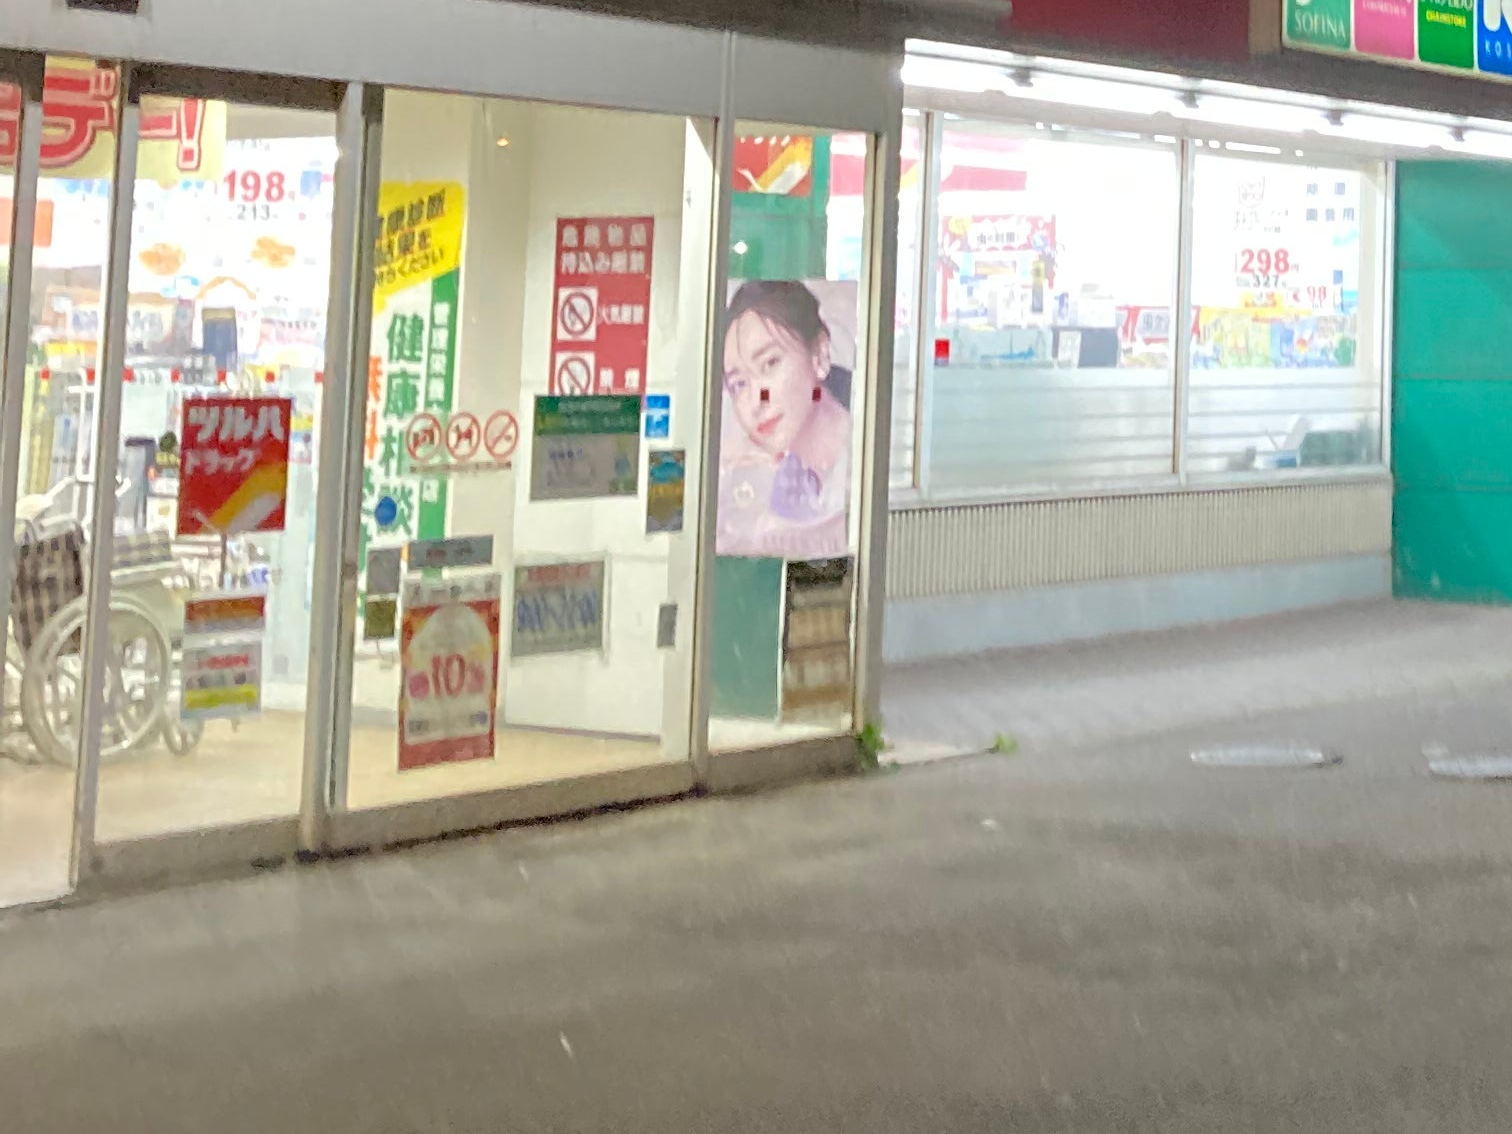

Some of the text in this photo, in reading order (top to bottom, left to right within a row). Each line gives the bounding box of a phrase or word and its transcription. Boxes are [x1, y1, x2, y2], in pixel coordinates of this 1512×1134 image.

[1295, 8, 1346, 42] SOFINA
[223, 169, 286, 202] 198
[1240, 247, 1290, 275] 298
[188, 405, 285, 443] ツルハ
